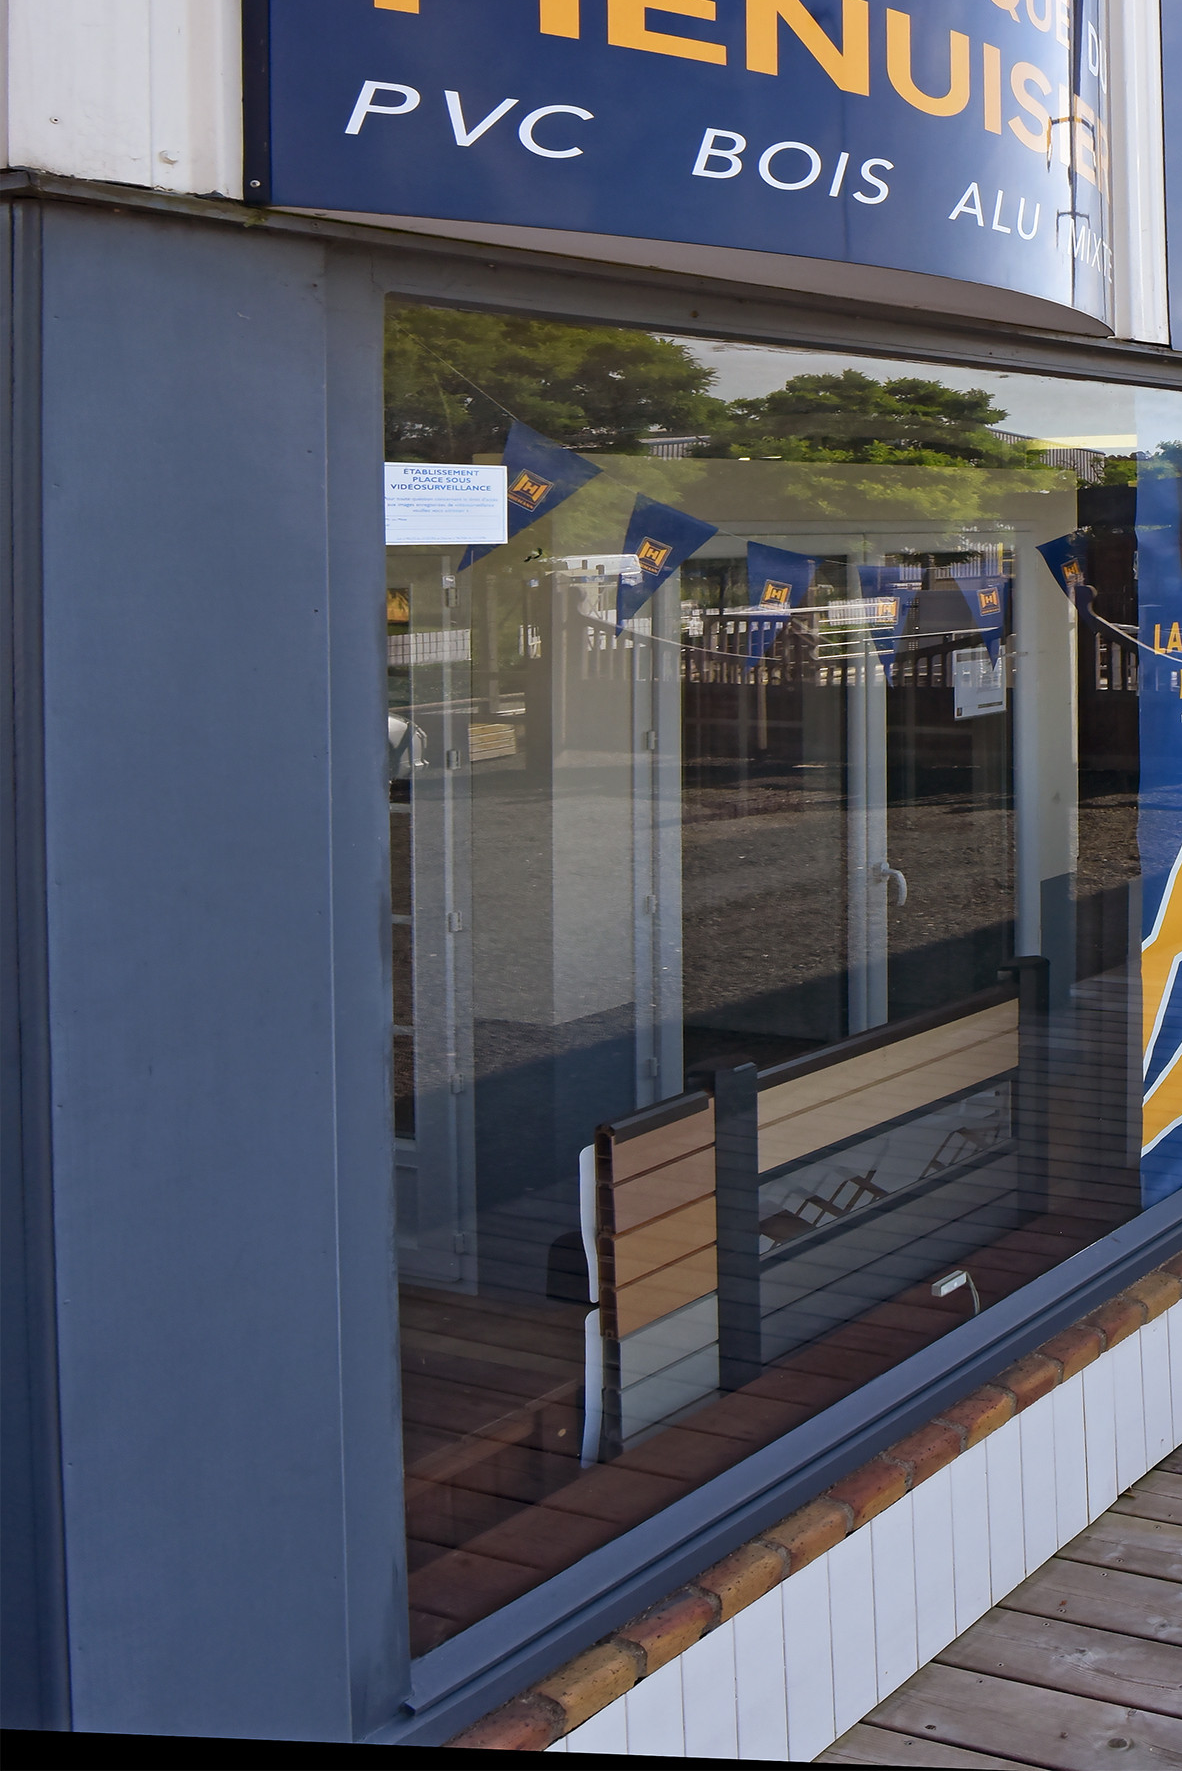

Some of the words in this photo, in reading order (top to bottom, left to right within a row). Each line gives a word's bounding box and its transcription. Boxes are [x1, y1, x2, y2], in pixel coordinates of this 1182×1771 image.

[344, 79, 595, 159] PVC
[692, 128, 894, 206] BOIS
[948, 181, 1041, 241] ALU
